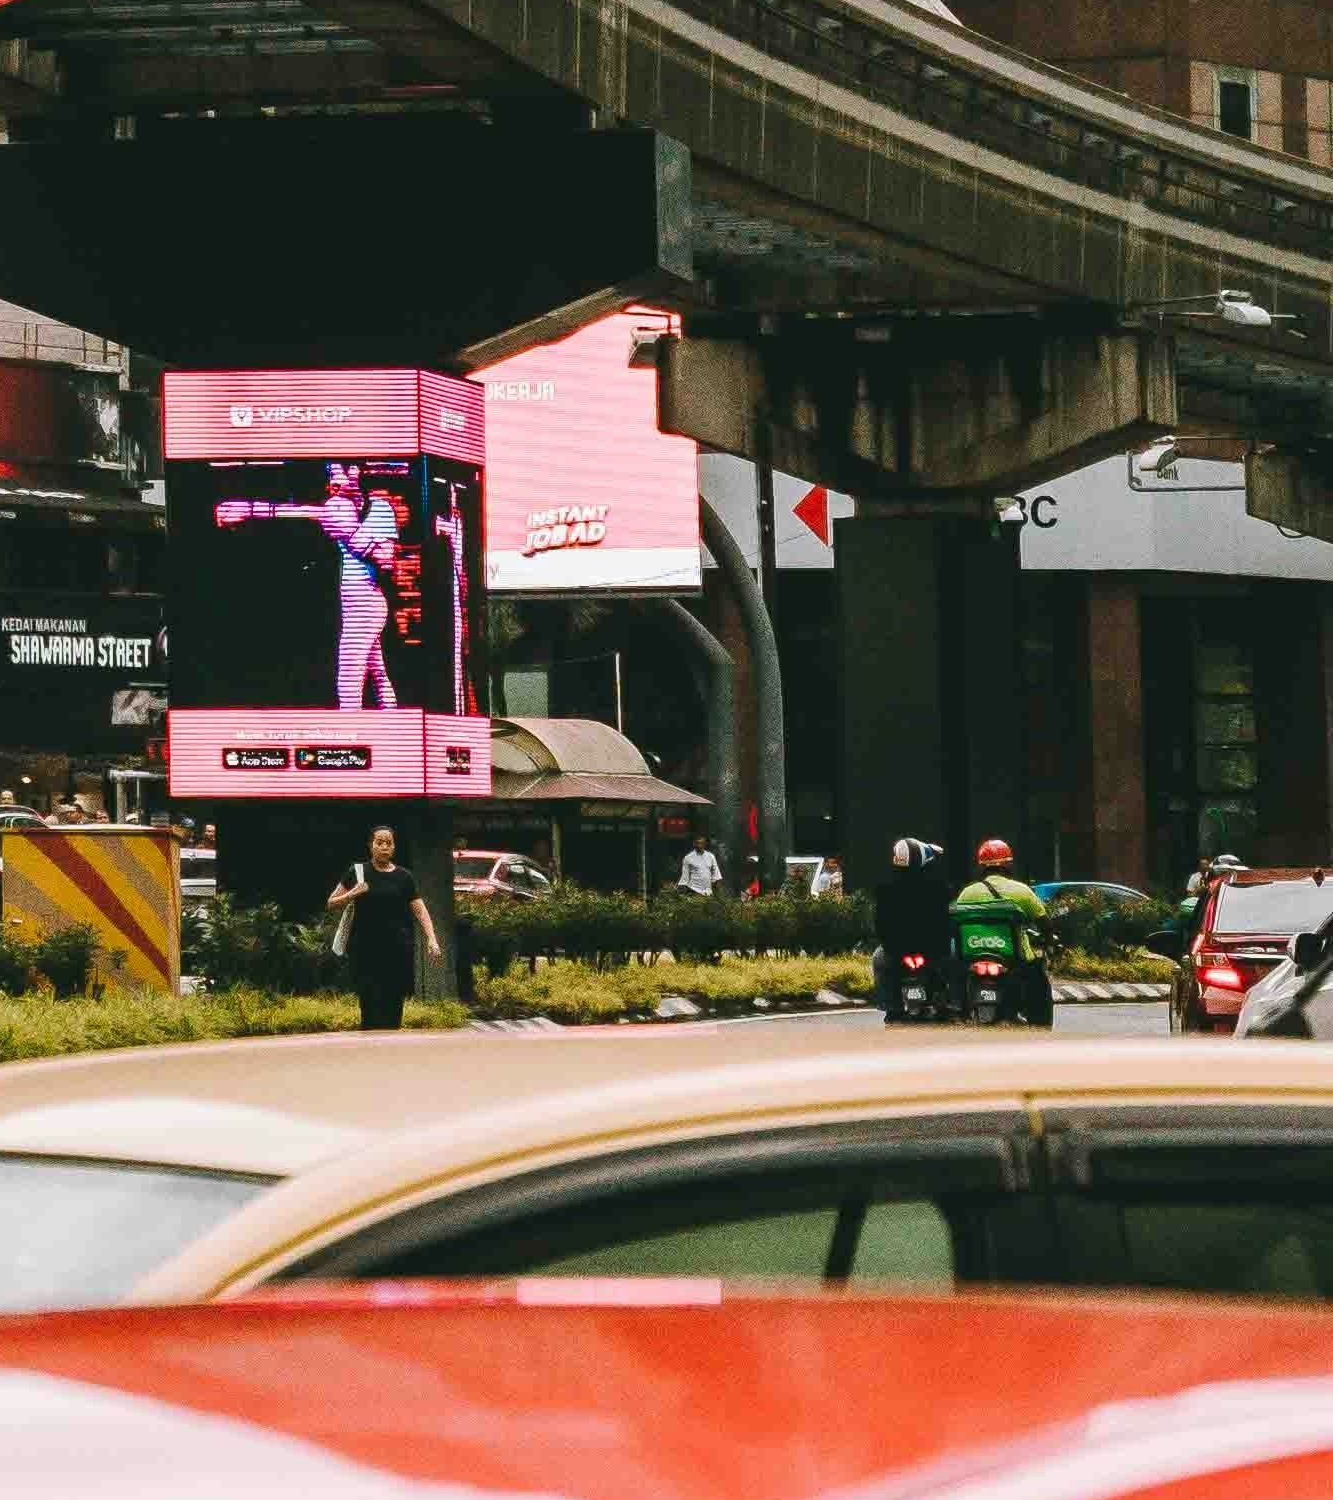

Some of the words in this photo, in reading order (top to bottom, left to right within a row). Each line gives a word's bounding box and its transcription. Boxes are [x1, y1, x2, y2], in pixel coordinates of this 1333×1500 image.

[527, 504, 609, 526] INSTANT
[523, 526, 567, 550] JOB
[569, 522, 607, 545] AD
[1, 618, 33, 632] KEDAI
[35, 619, 86, 633] MAKANAN
[10, 635, 94, 665] SHAWARMA
[97, 637, 152, 668] STREET
[317, 755, 347, 767] Google
[349, 755, 367, 767] Play
[967, 935, 1006, 948] Grab
